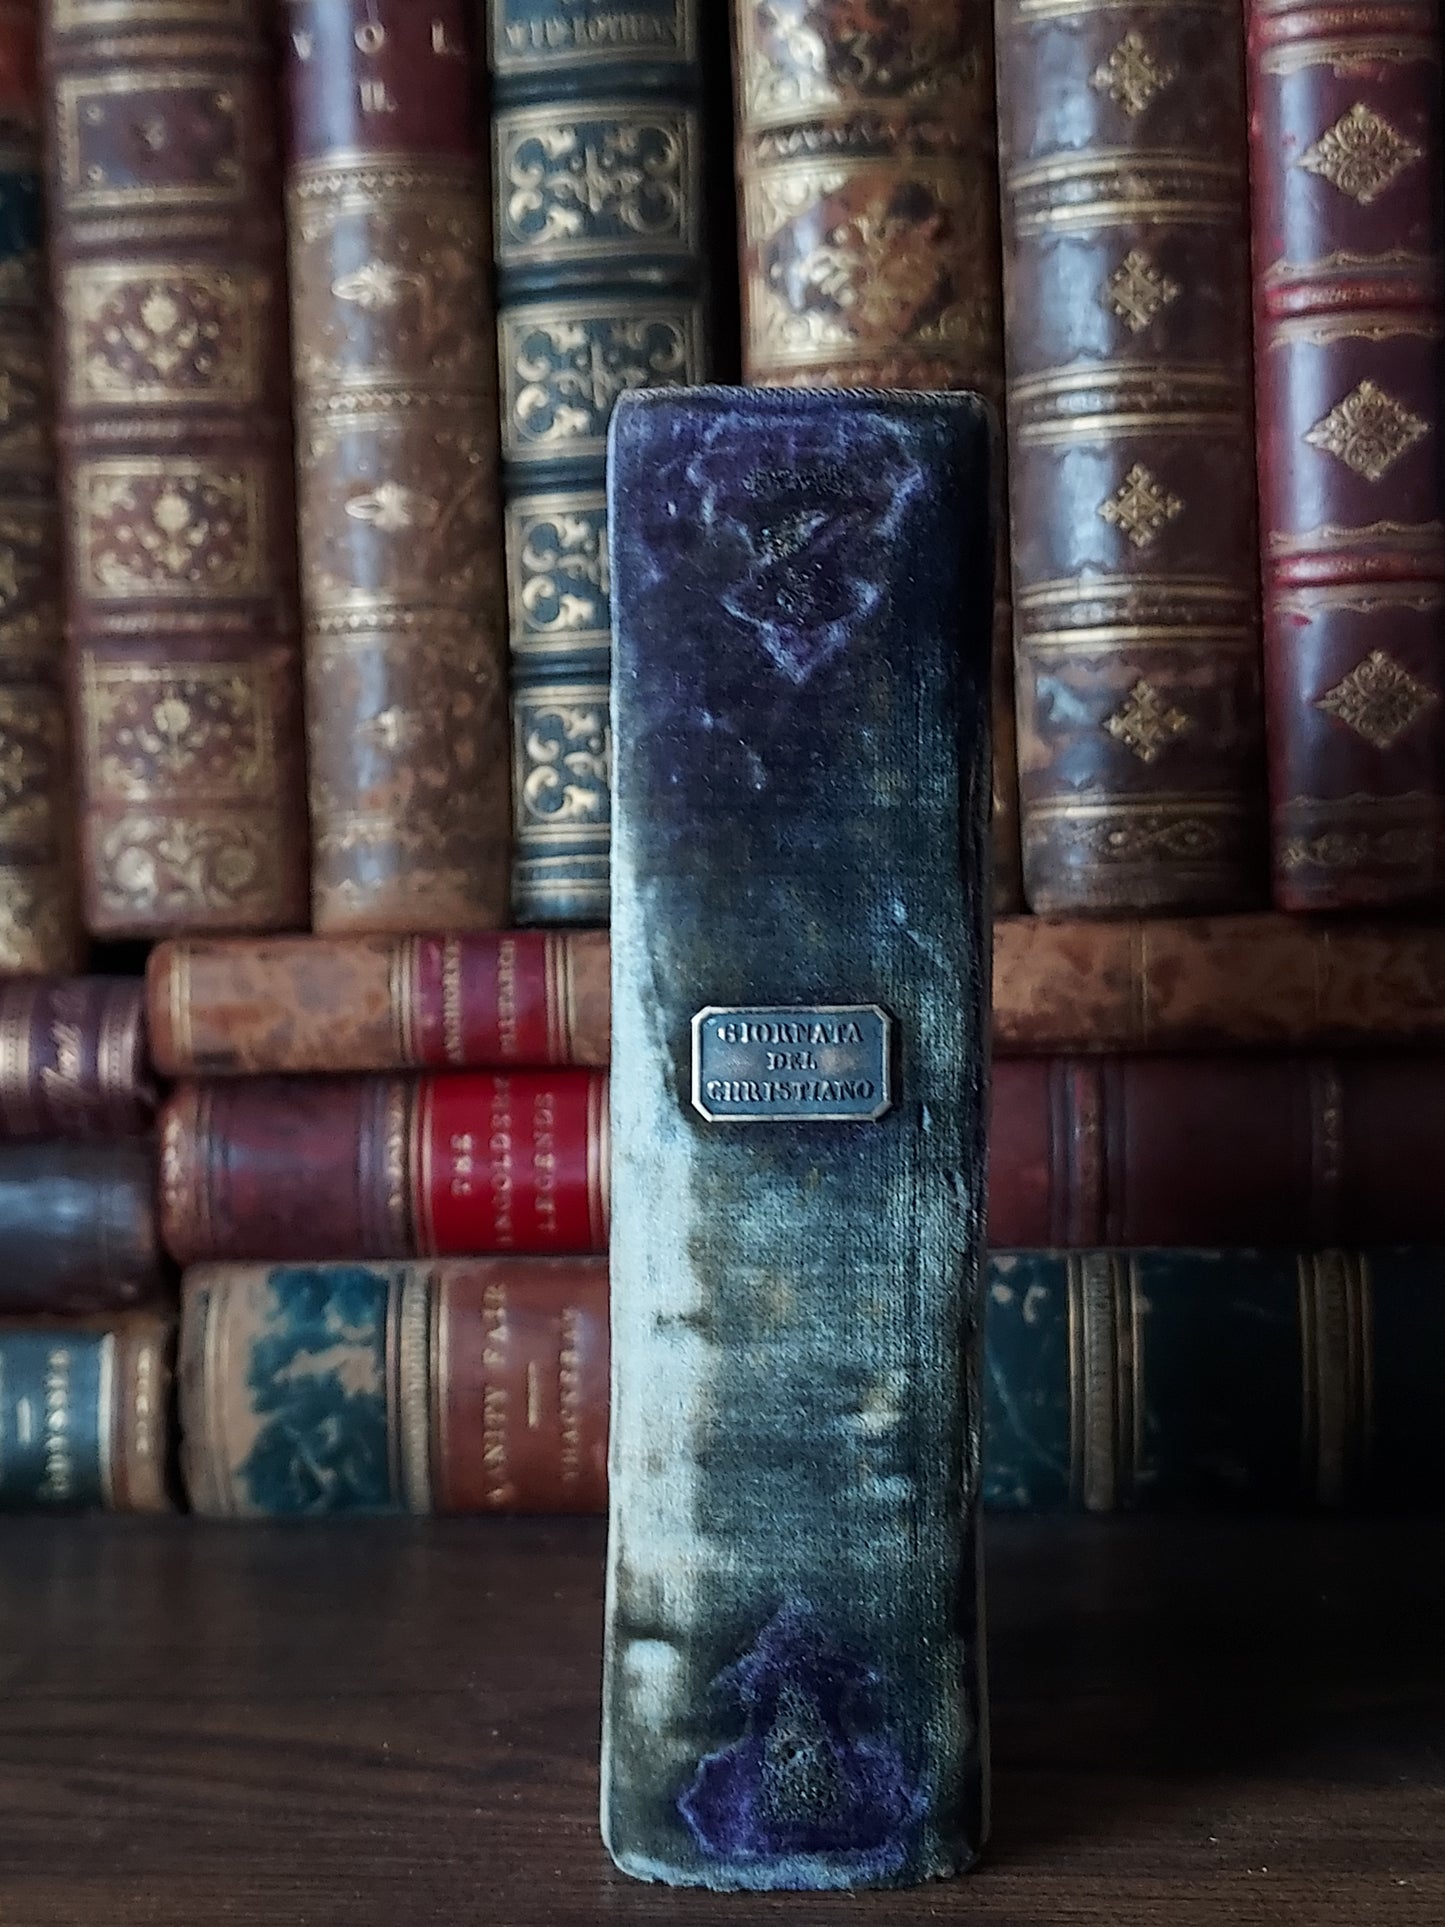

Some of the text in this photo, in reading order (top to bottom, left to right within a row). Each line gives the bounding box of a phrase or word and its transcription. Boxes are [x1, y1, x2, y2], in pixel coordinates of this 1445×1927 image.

[716, 1021, 866, 1045] GIORNATA
[766, 1050, 818, 1071] DEL
[705, 1079, 876, 1102] CHRISTIANO
